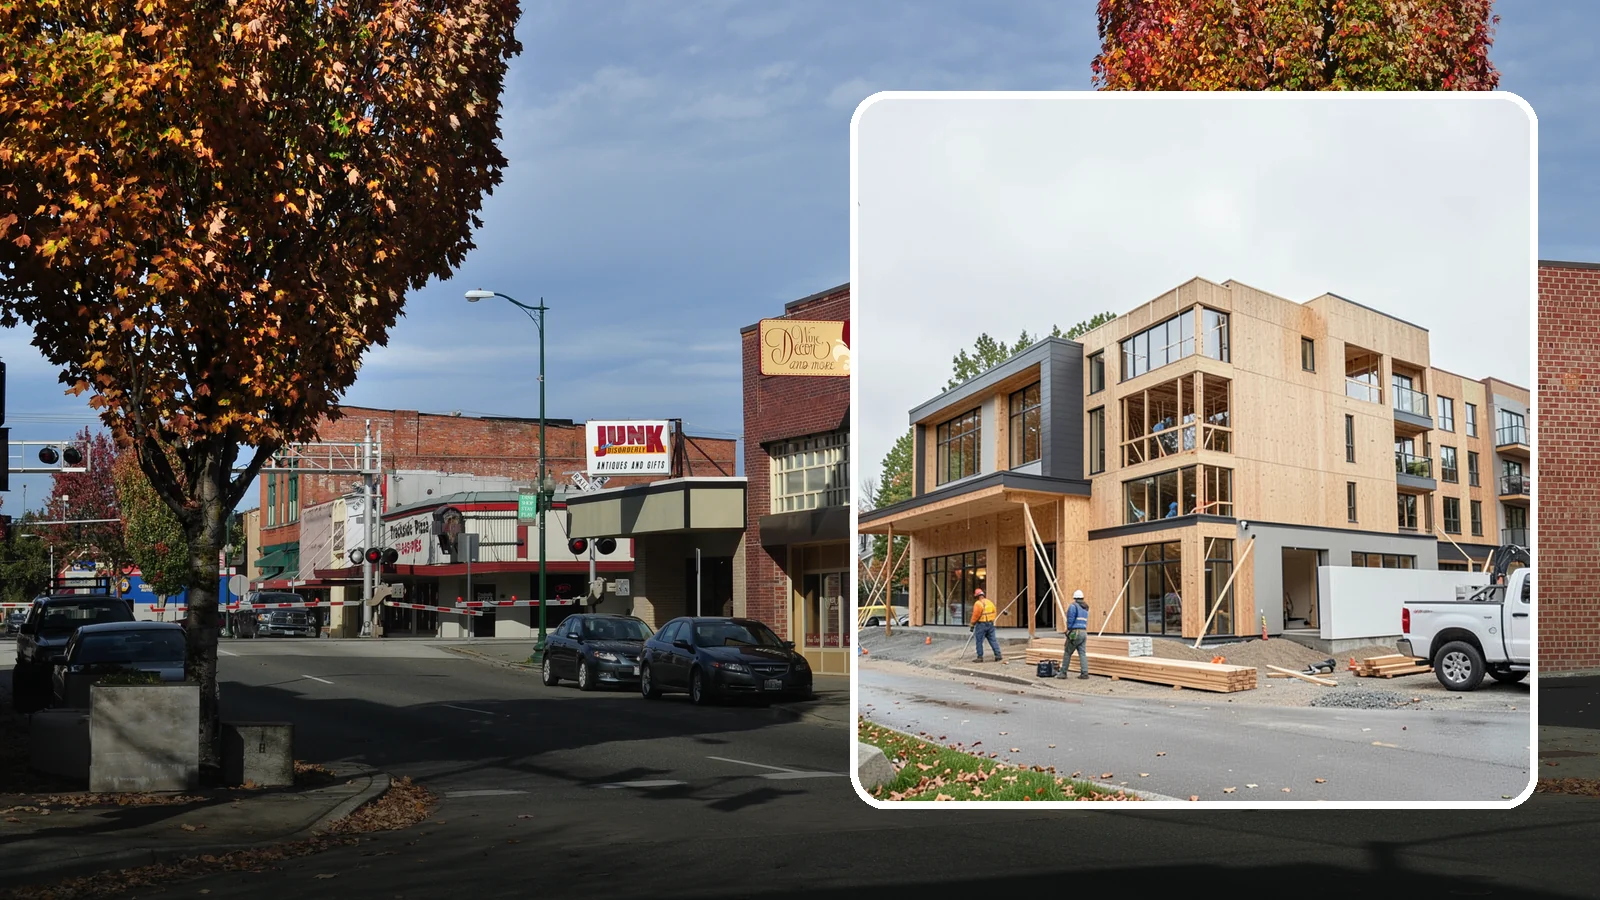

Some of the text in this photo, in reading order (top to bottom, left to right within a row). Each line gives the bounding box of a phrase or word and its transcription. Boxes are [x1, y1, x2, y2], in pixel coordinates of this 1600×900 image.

[765, 328, 831, 365] Decor
[595, 425, 665, 457] JUNK
[607, 446, 646, 454] DISORDERLY
[597, 461, 665, 470] ANTIQUES AND GIFTS
[573, 473, 589, 492] RAIL
[390, 519, 429, 539] Trackside Pizza
